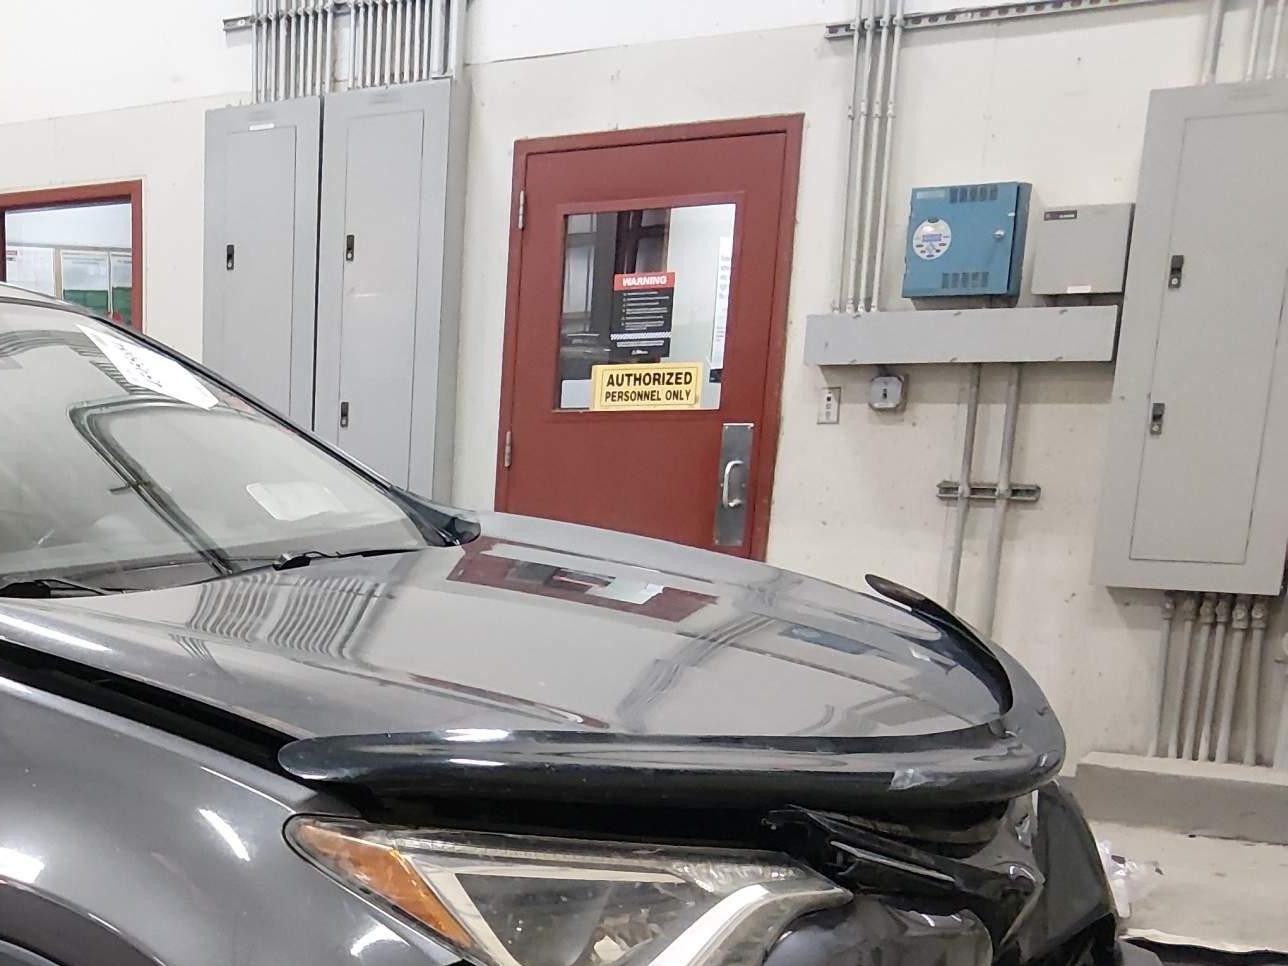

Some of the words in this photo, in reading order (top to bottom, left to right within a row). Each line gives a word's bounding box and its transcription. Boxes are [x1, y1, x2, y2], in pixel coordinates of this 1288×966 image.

[622, 275, 668, 287] WARNING
[606, 371, 693, 387] AUTHORIZED
[604, 390, 662, 402] PERSONNEL
[665, 389, 692, 401] ONLY
